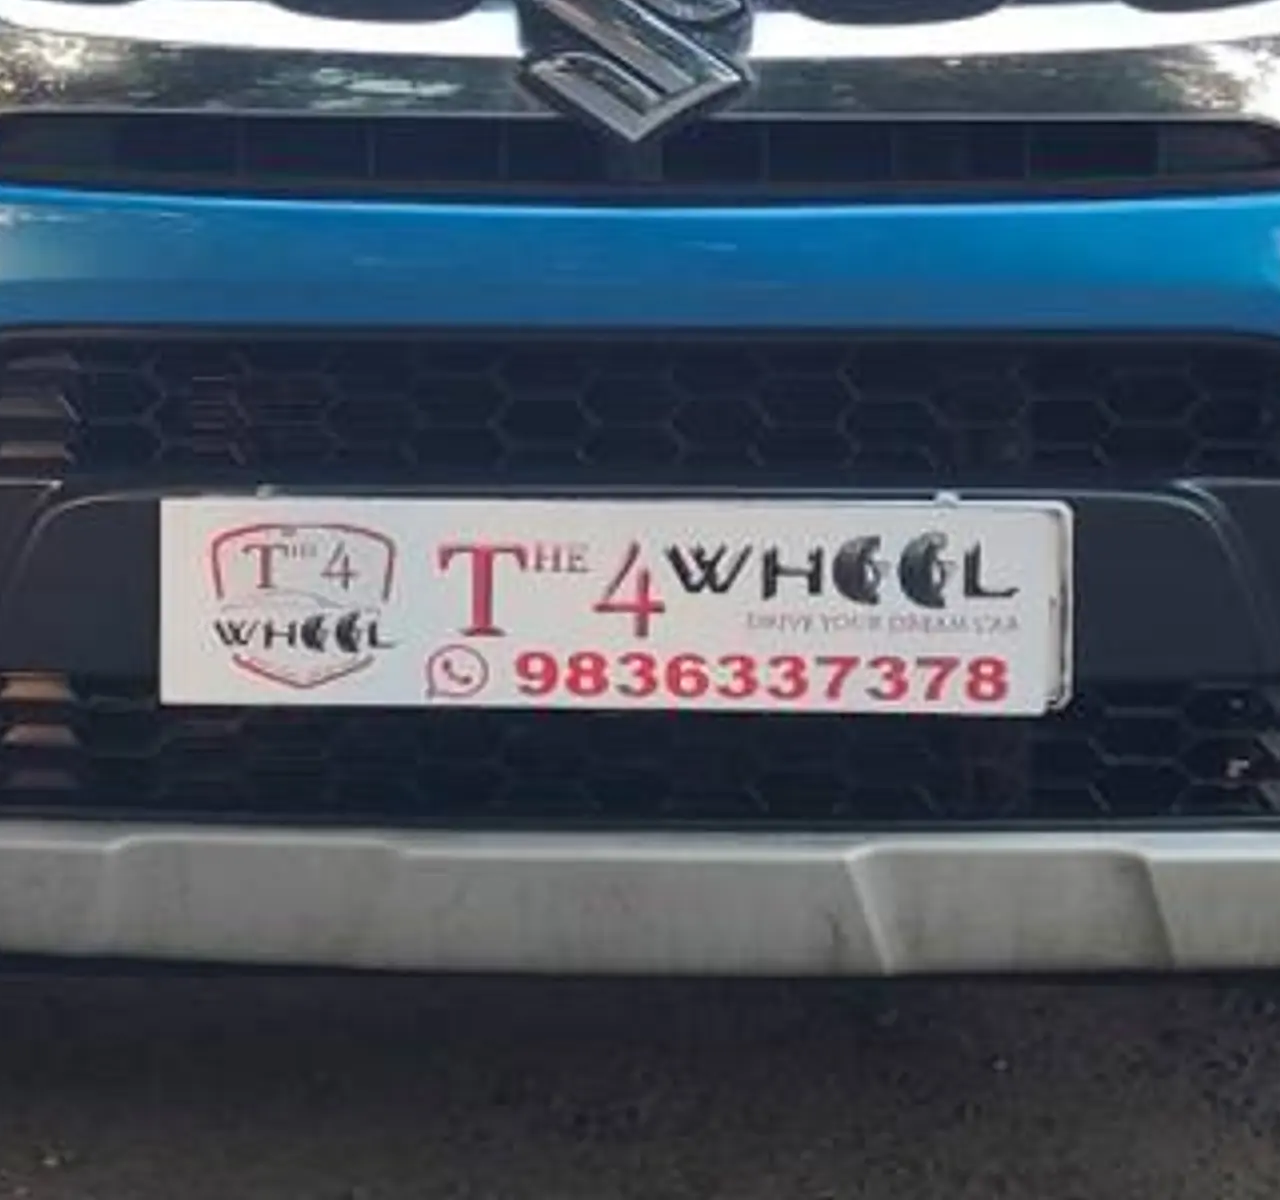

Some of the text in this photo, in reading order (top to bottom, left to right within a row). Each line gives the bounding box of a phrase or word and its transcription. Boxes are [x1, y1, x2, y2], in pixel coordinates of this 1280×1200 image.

[320, 540, 359, 590] 4
[438, 532, 1021, 638] THE 4 WHEEL
[213, 611, 396, 653] WHEEL
[514, 651, 1010, 701] 9836337378
